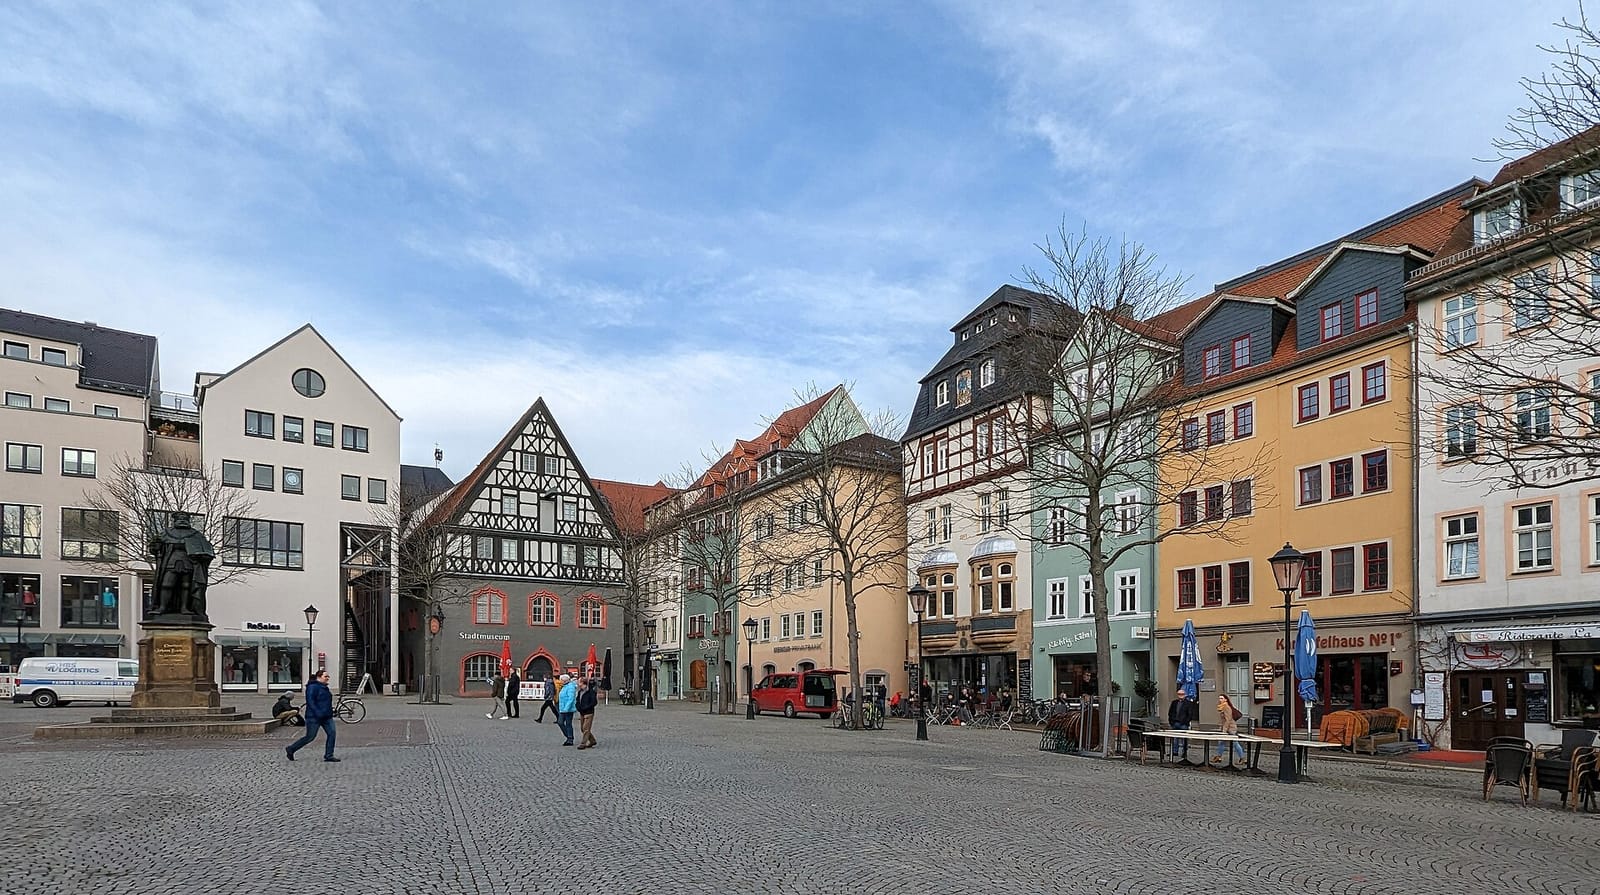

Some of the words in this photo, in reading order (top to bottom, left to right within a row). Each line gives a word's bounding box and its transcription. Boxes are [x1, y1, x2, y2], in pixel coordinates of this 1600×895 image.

[246, 622, 281, 631] ReSales
[459, 631, 510, 641] Stadtmuseum
[1498, 631, 1564, 641] Ristorante
[1570, 627, 1592, 639] La
